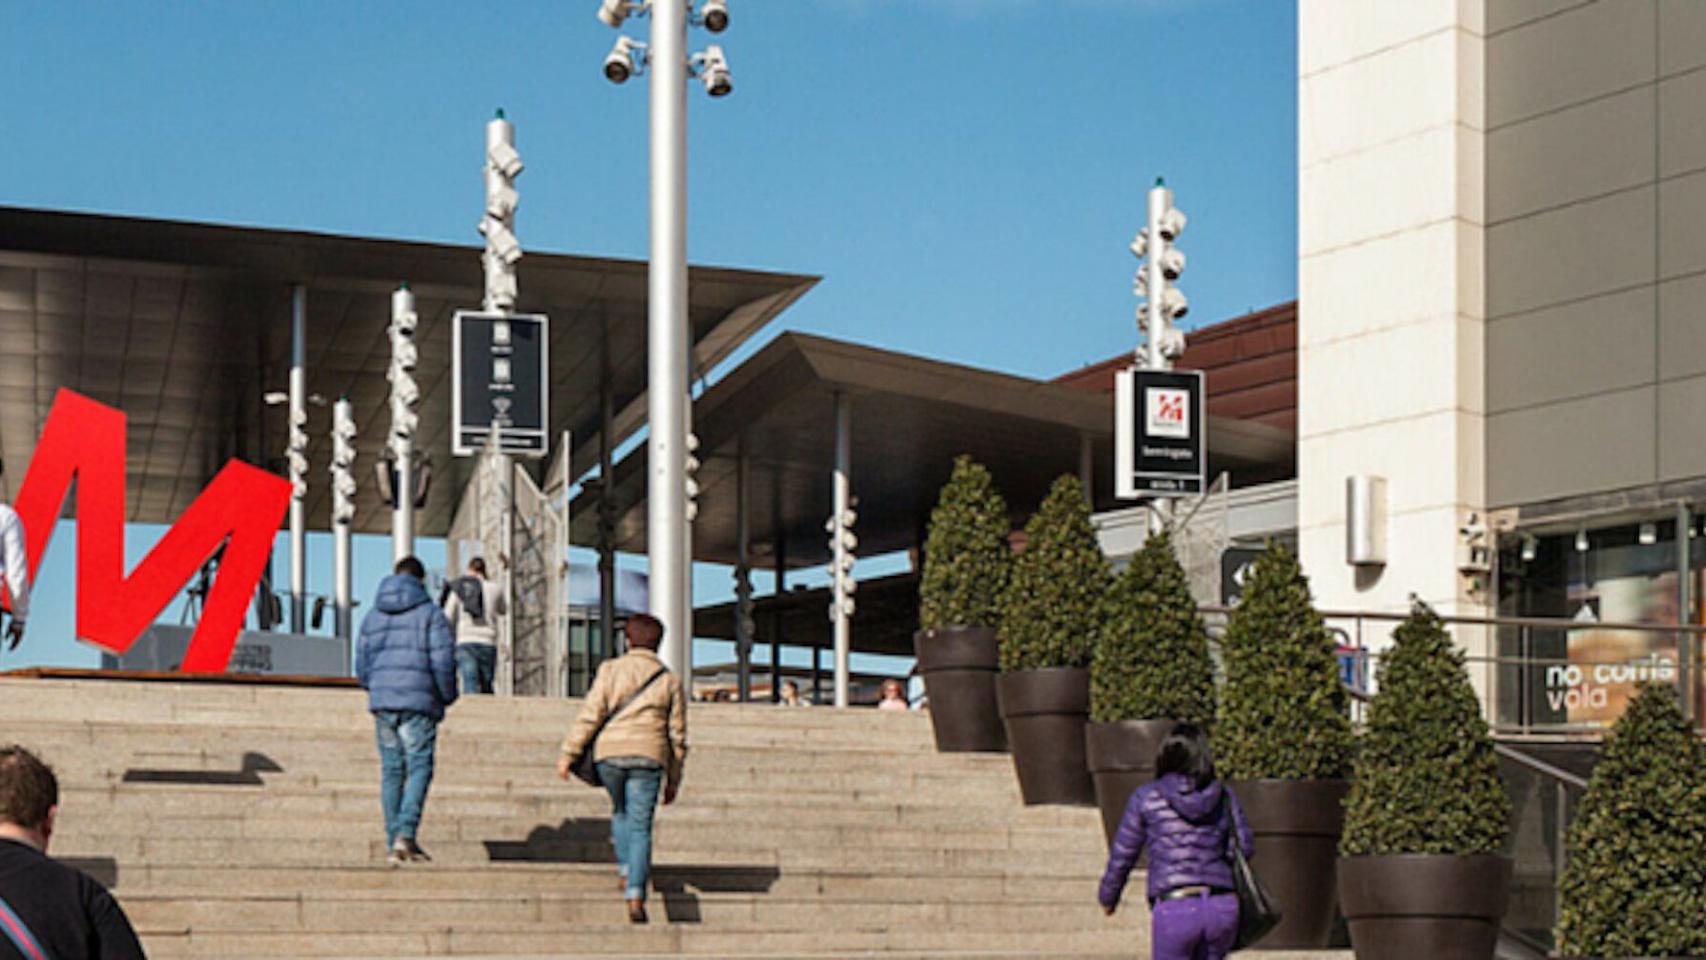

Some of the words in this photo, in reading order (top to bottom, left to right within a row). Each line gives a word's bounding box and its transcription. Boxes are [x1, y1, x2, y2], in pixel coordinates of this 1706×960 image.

[0, 386, 293, 673] M
[1546, 664, 1582, 687] no
[1546, 683, 1607, 711] vola
